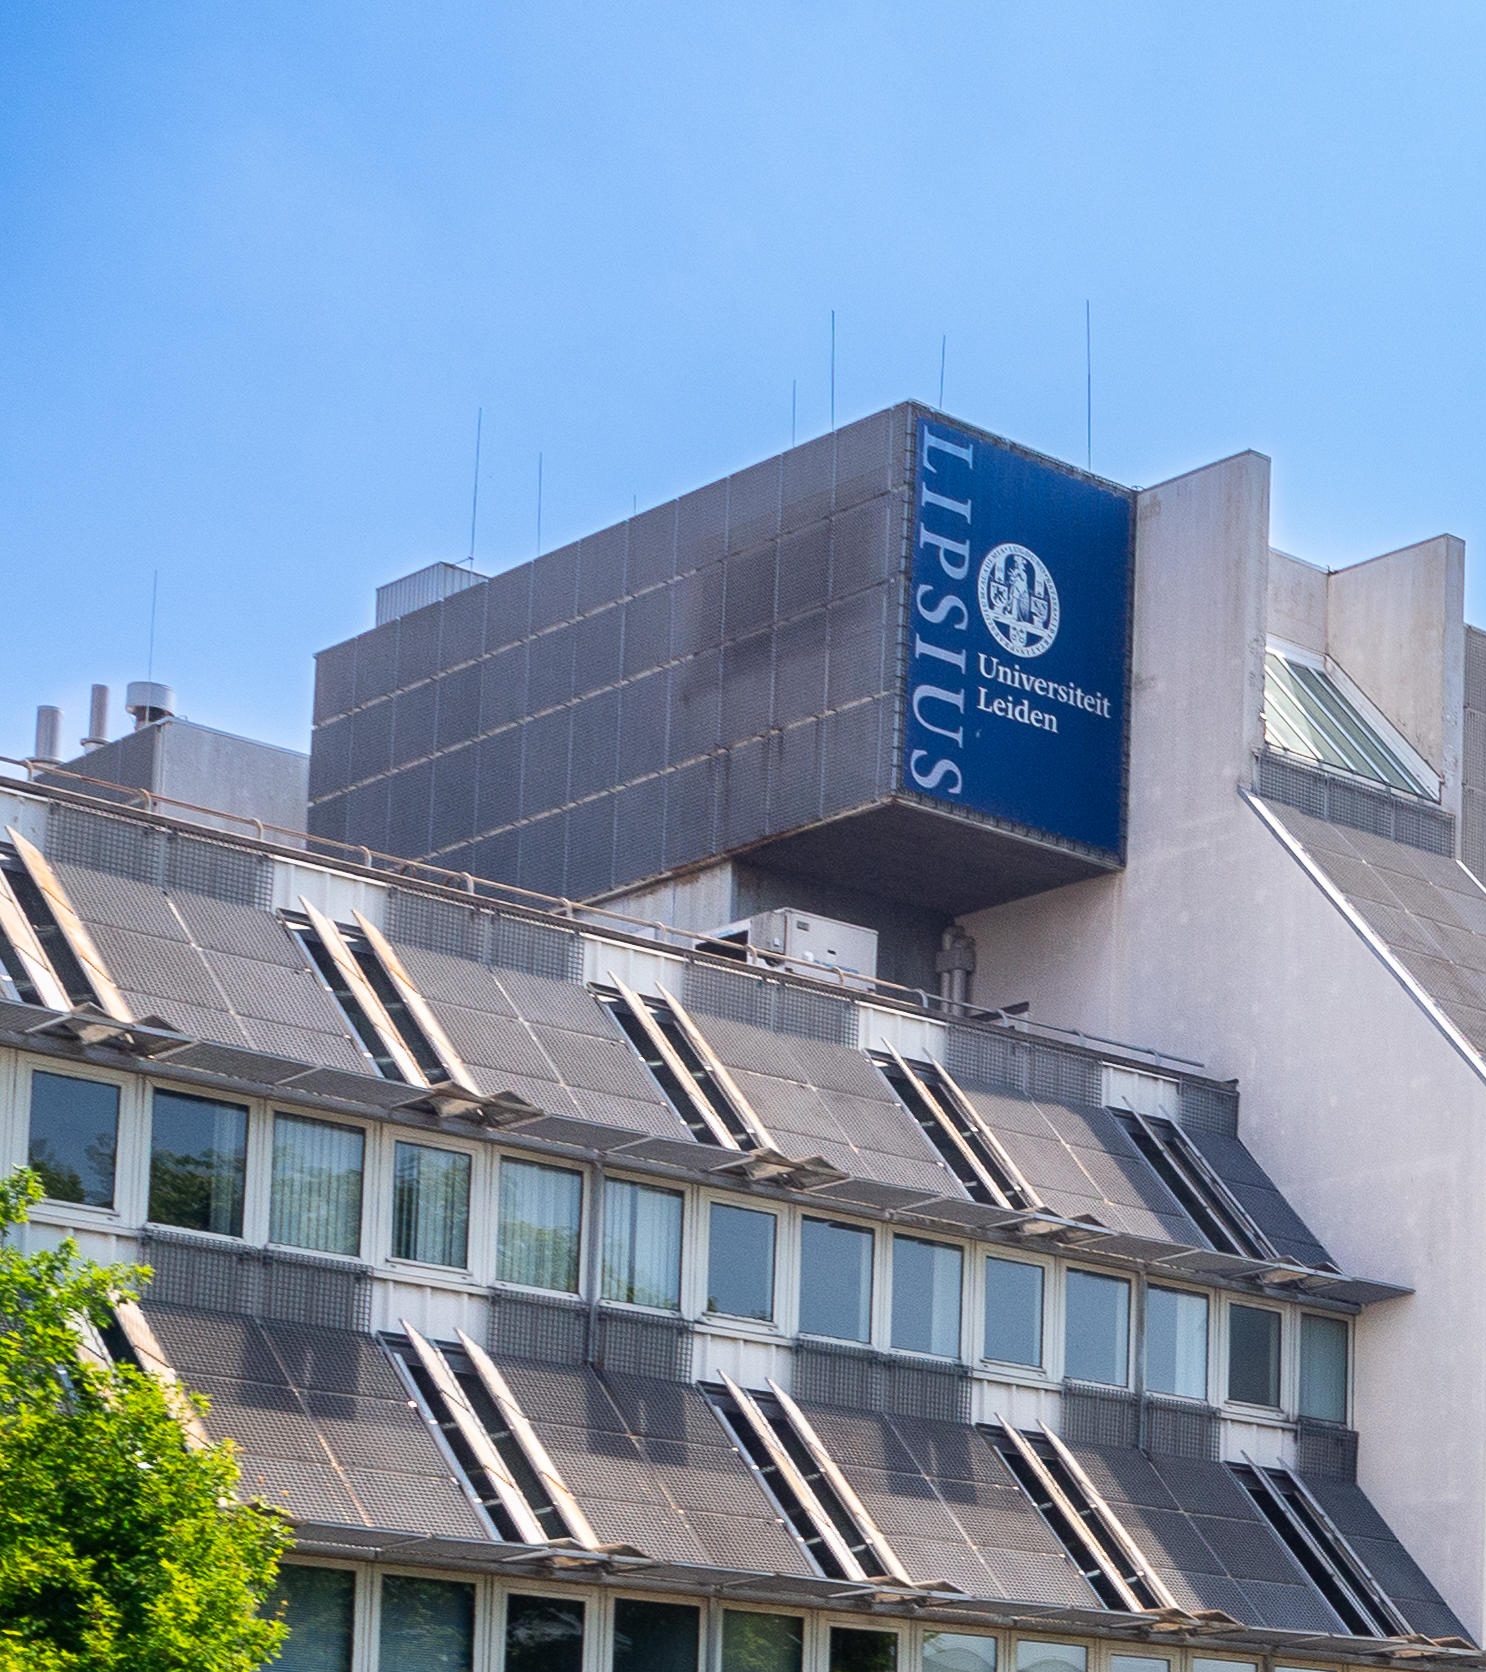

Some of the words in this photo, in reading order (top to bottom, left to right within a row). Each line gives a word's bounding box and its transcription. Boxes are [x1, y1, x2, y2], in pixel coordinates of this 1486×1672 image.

[909, 425, 974, 796] LIPSIUS
[977, 652, 1112, 719] Universiteit
[977, 687, 1059, 734] Leiden
